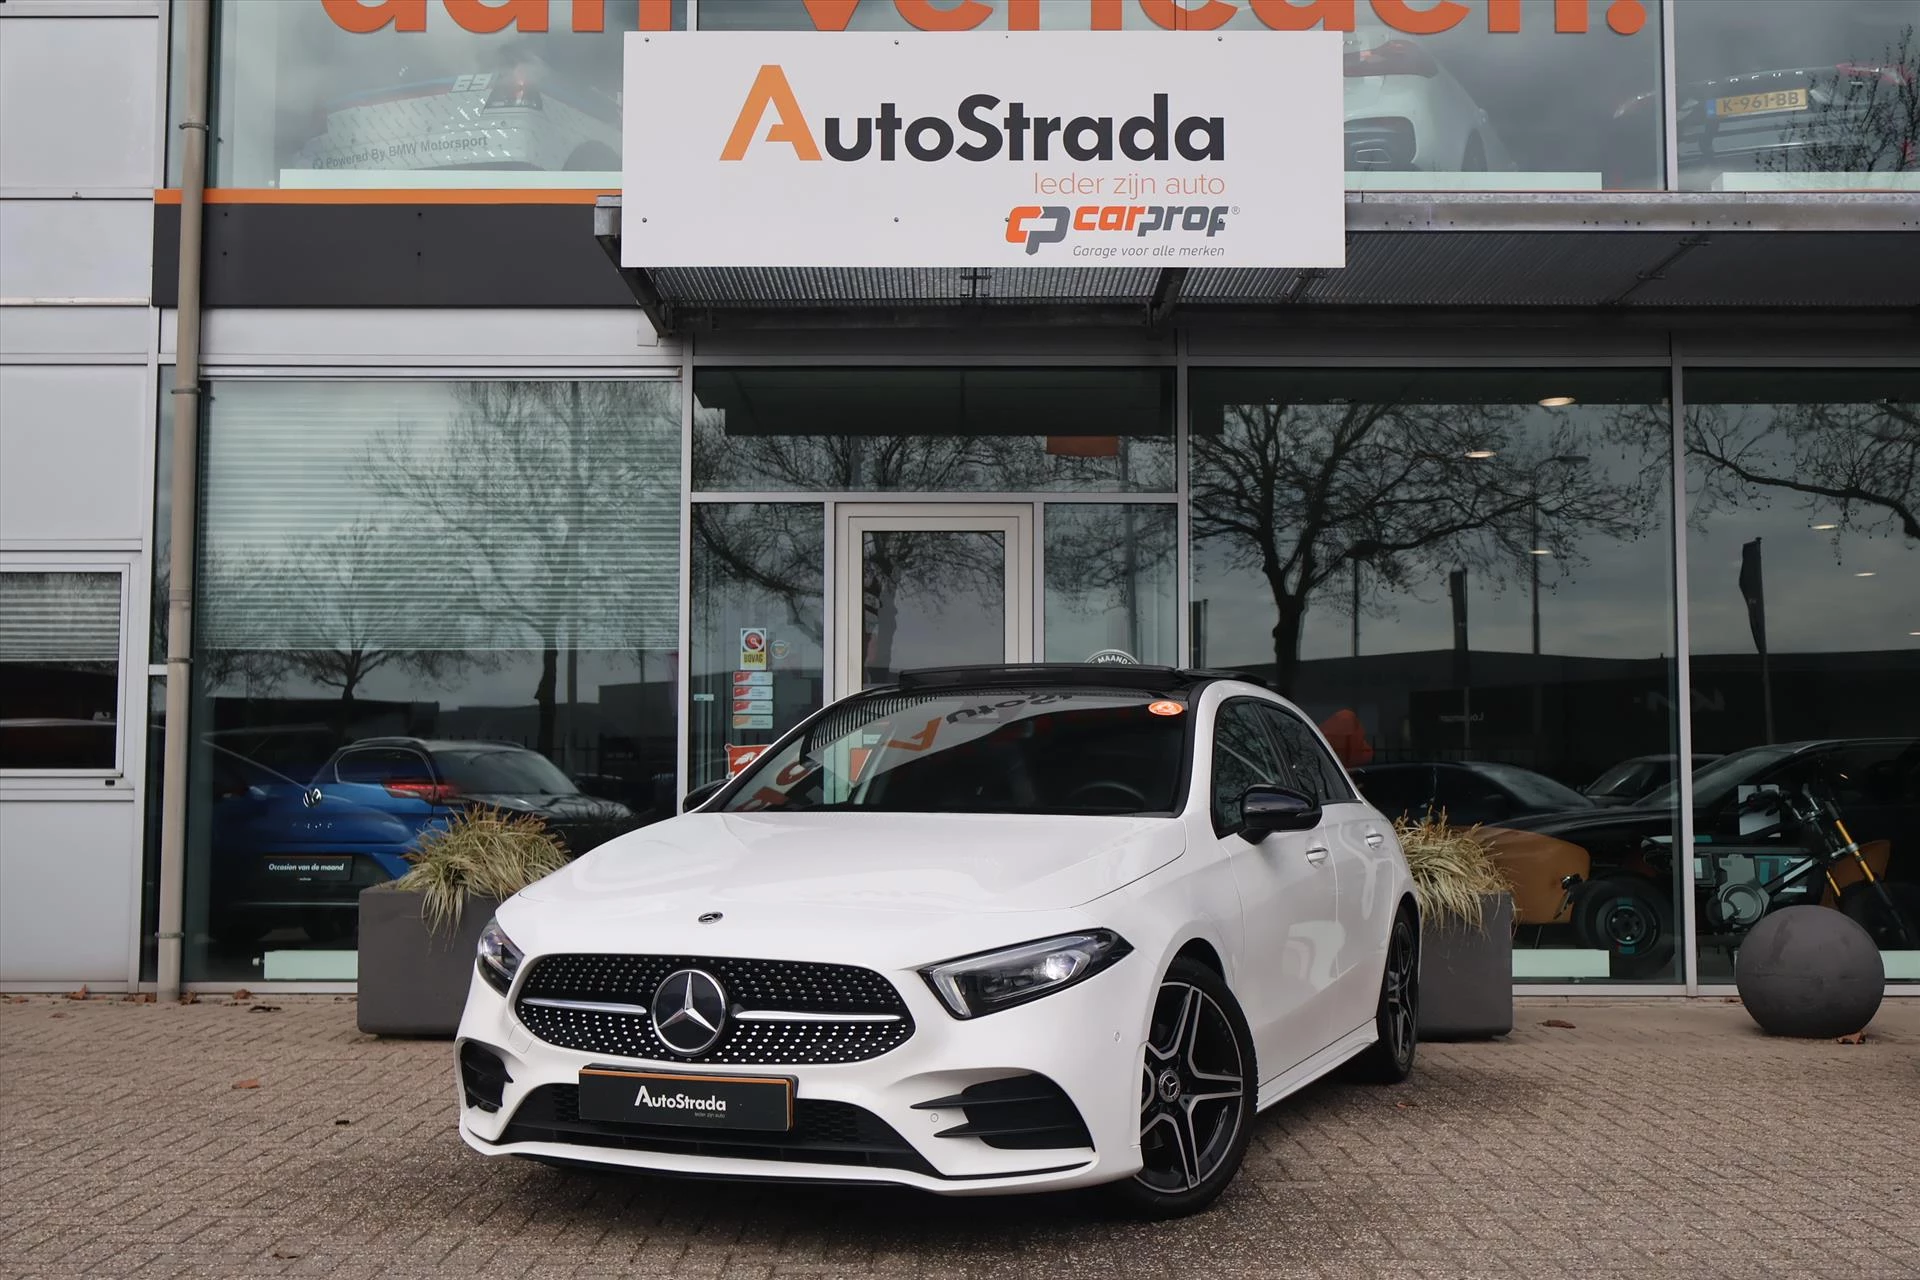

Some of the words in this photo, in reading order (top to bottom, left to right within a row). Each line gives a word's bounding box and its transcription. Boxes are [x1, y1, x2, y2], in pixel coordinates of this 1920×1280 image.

[452, 73, 493, 92] 69
[718, 63, 1226, 163] AutoStrada
[1723, 92, 1799, 113] K-961-BB
[388, 142, 417, 157] BMW
[420, 135, 488, 153] Motorsport
[1112, 172, 1156, 201] zijn
[1165, 173, 1226, 195] auto
[1072, 205, 1230, 238] carprof
[1072, 245, 1117, 259] Garage
[1121, 246, 1150, 258] voor
[1151, 244, 1176, 258] alle
[1178, 245, 1226, 258] merken
[268, 863, 297, 871] Occasion
[311, 862, 320, 871] de
[320, 862, 345, 871] maand
[634, 1085, 726, 1111] AutoStrada
